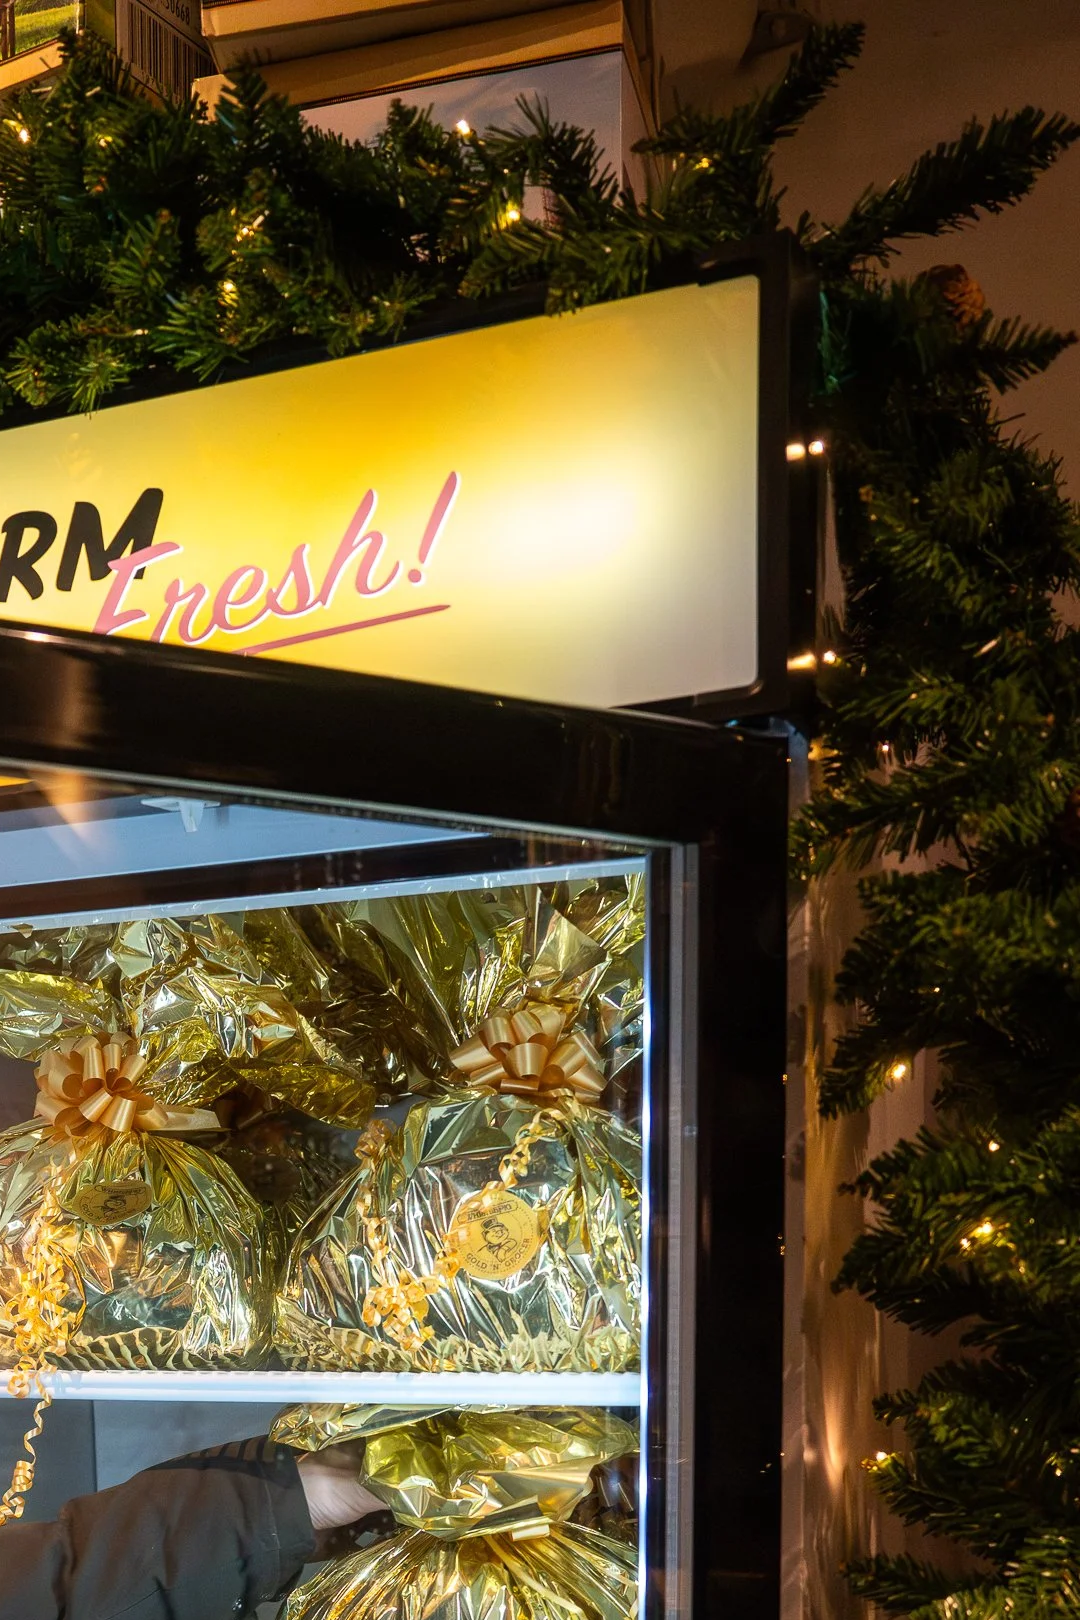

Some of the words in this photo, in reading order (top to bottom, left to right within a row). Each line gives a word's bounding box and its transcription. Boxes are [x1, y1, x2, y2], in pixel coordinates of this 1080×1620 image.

[92, 471, 459, 646] Fresh!
[466, 1252, 487, 1269] GOLD
[505, 1238, 530, 1267] GROCER
